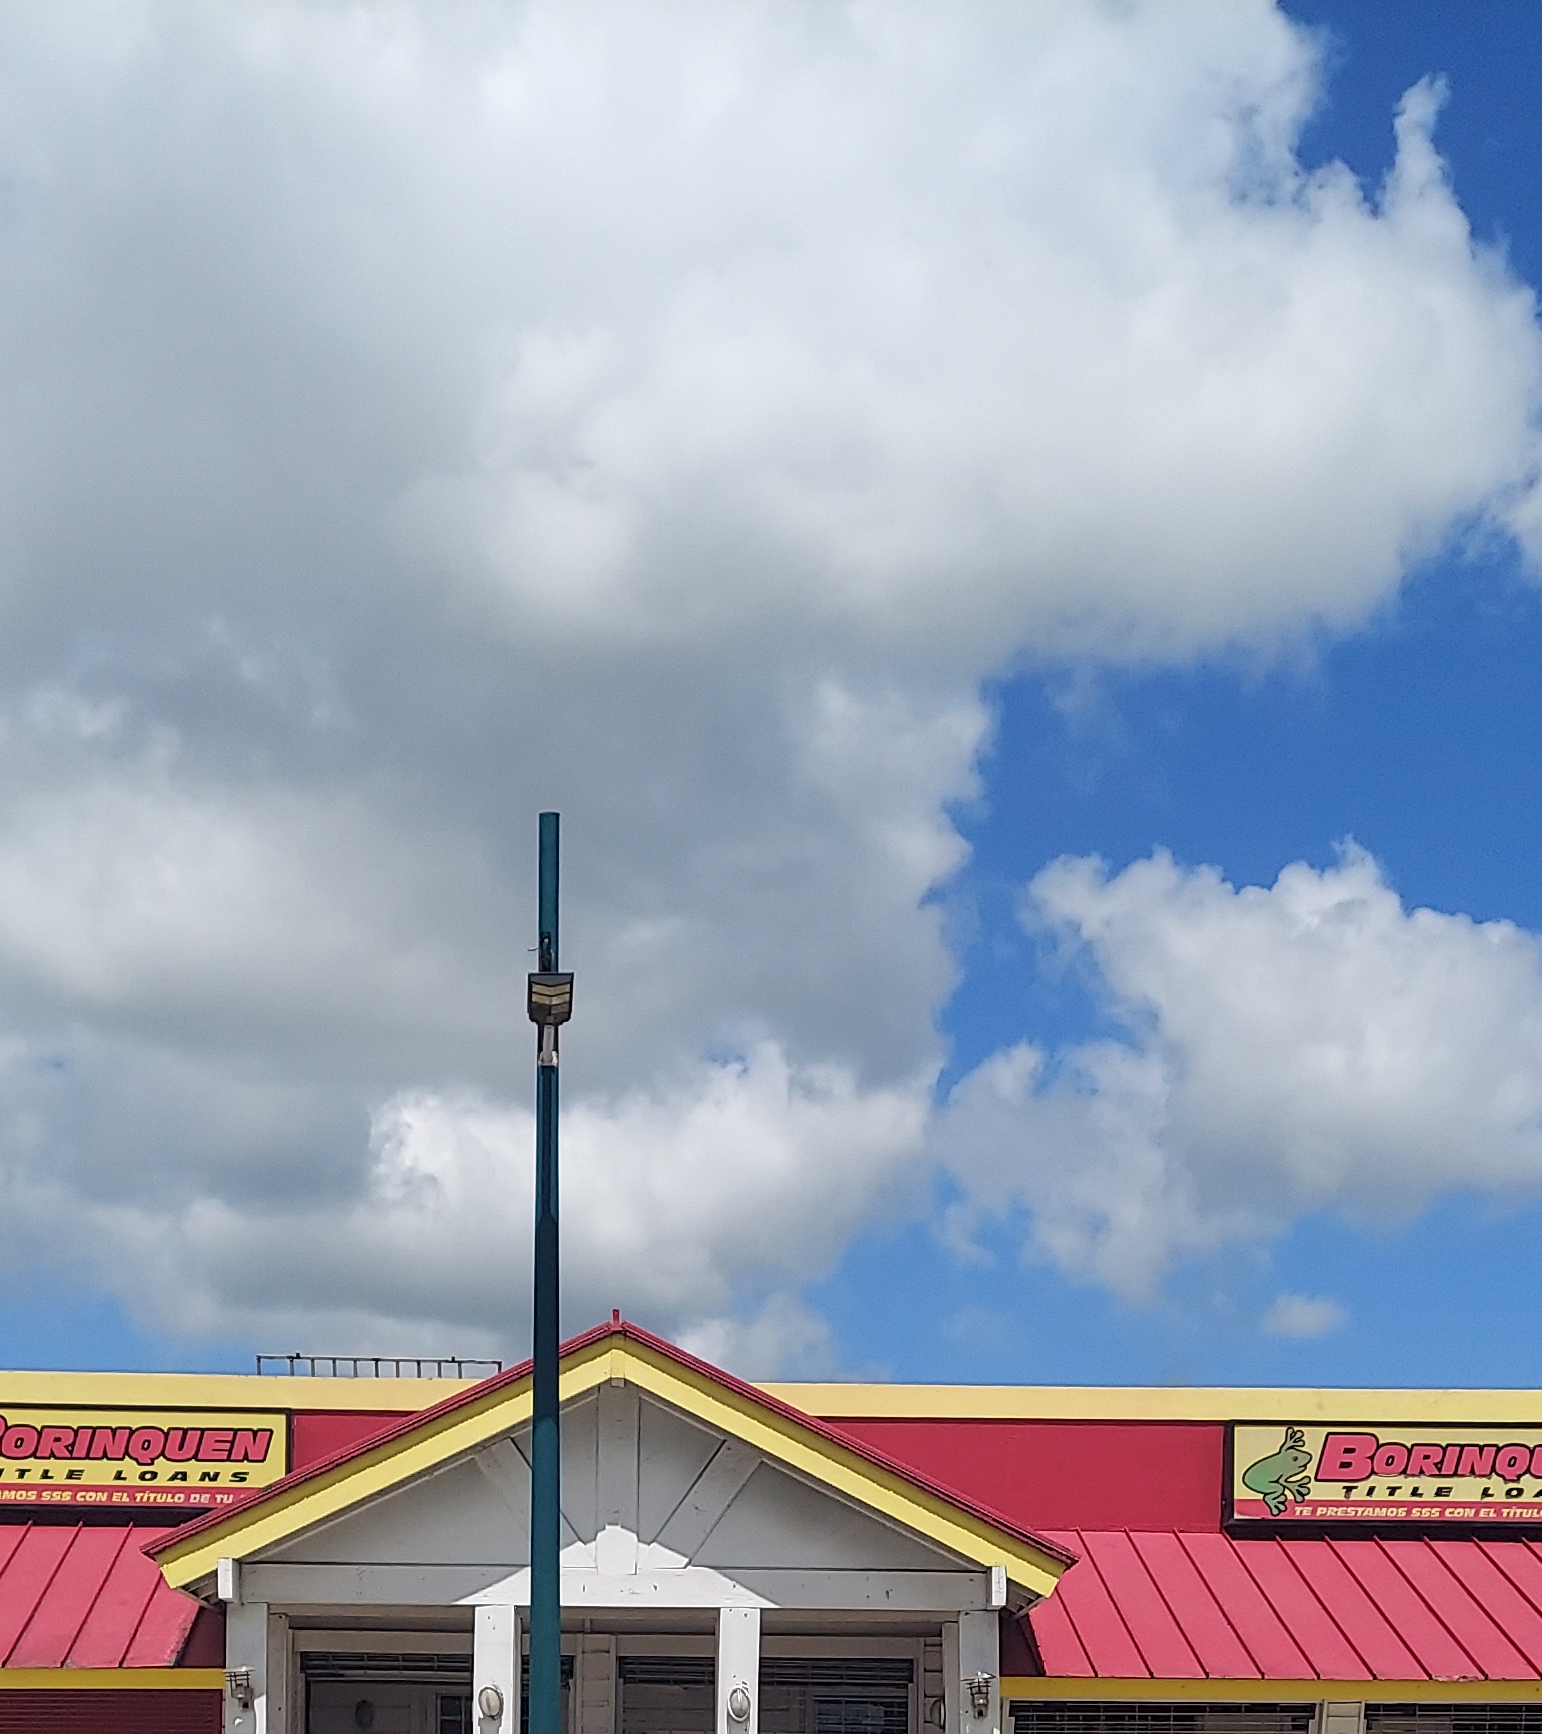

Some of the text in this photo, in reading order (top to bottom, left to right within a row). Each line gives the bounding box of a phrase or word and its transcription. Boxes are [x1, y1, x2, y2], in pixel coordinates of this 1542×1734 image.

[113, 1469, 250, 1483] LOANS
[76, 1491, 108, 1502] CON
[112, 1492, 130, 1502] EL
[189, 1493, 210, 1503] DE
[215, 1494, 234, 1504] TU
[1341, 1485, 1453, 1499] TITLE
[1294, 1506, 1313, 1516] TE
[1316, 1507, 1408, 1517] PRESTAMOS
[1445, 1508, 1476, 1518] CON
[1479, 1508, 1497, 1518] EL
